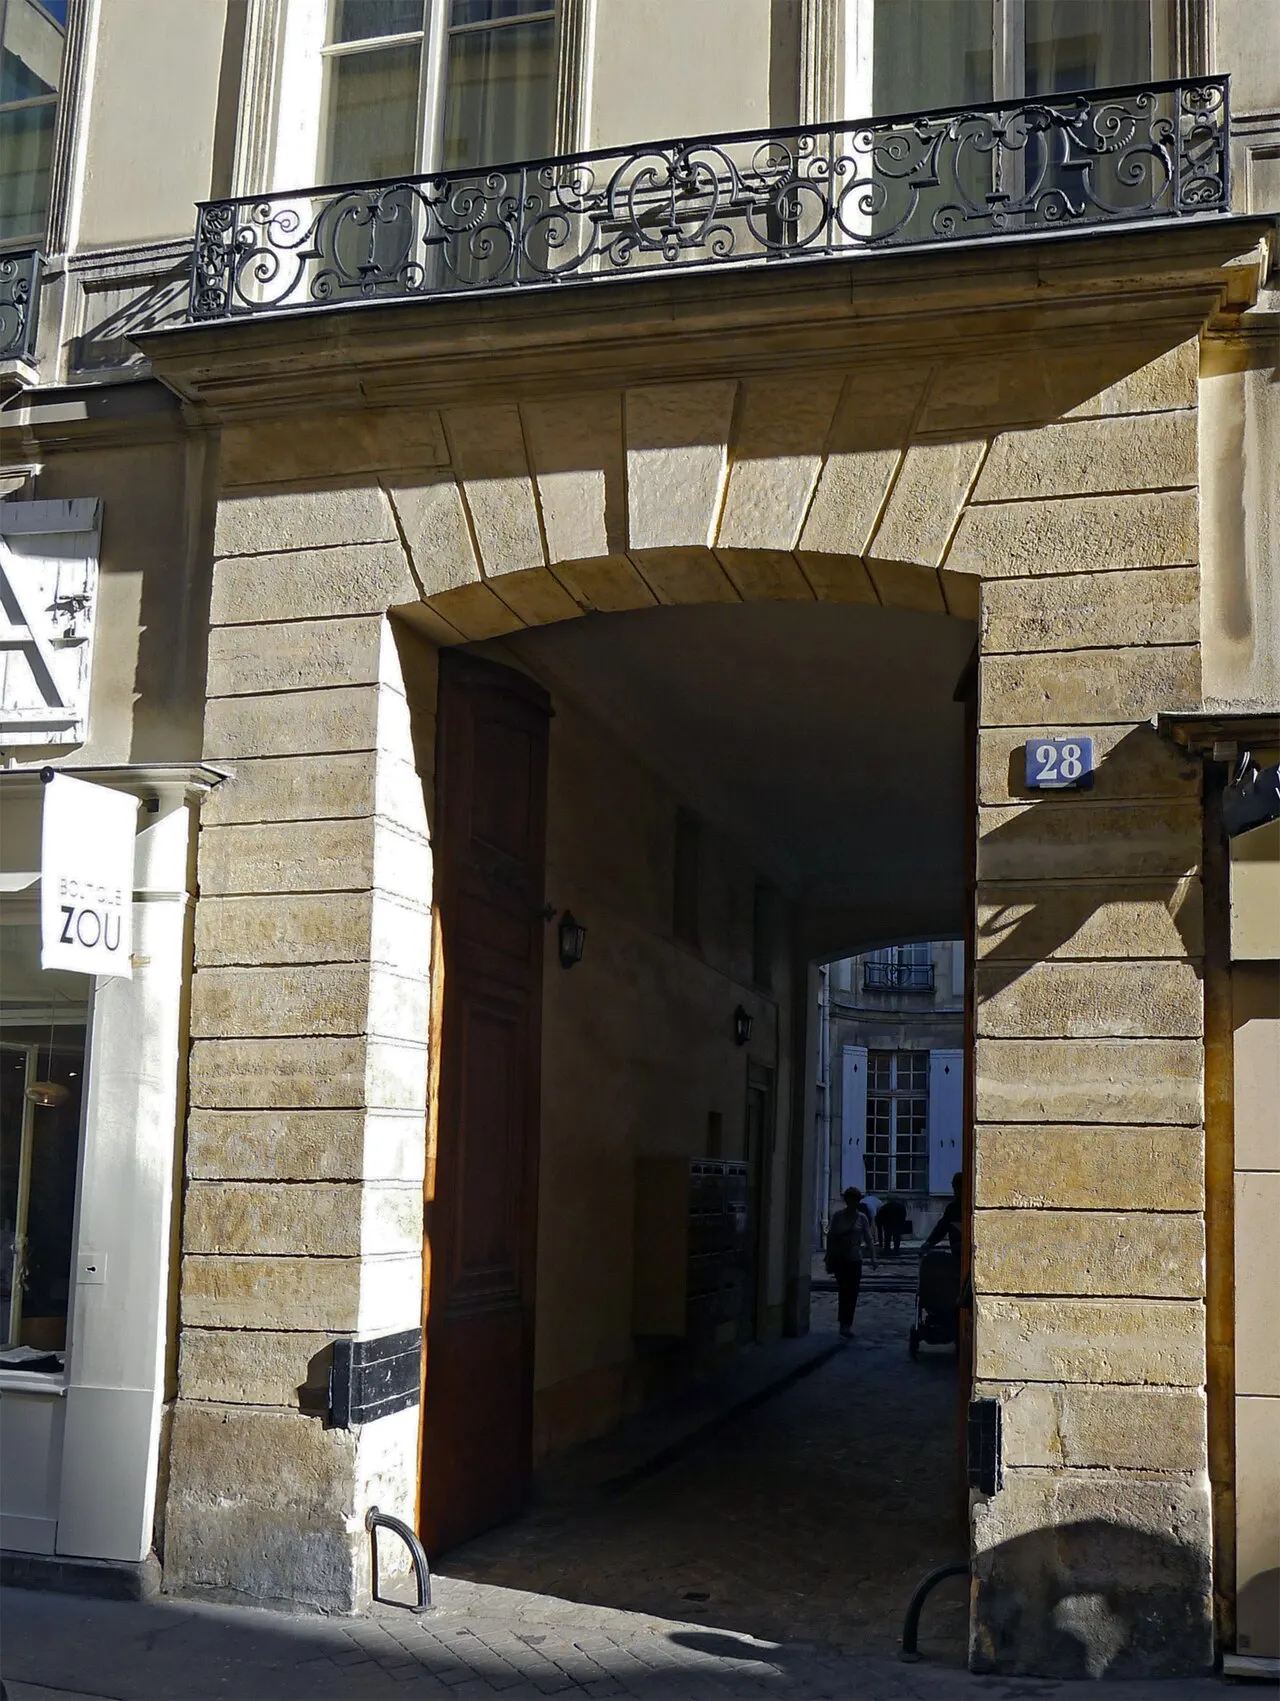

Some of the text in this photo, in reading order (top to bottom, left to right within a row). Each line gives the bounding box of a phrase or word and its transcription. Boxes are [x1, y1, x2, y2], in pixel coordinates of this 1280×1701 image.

[1036, 744, 1082, 780] 28
[59, 878, 122, 907] BOTQE
[59, 904, 122, 951] ZOU
